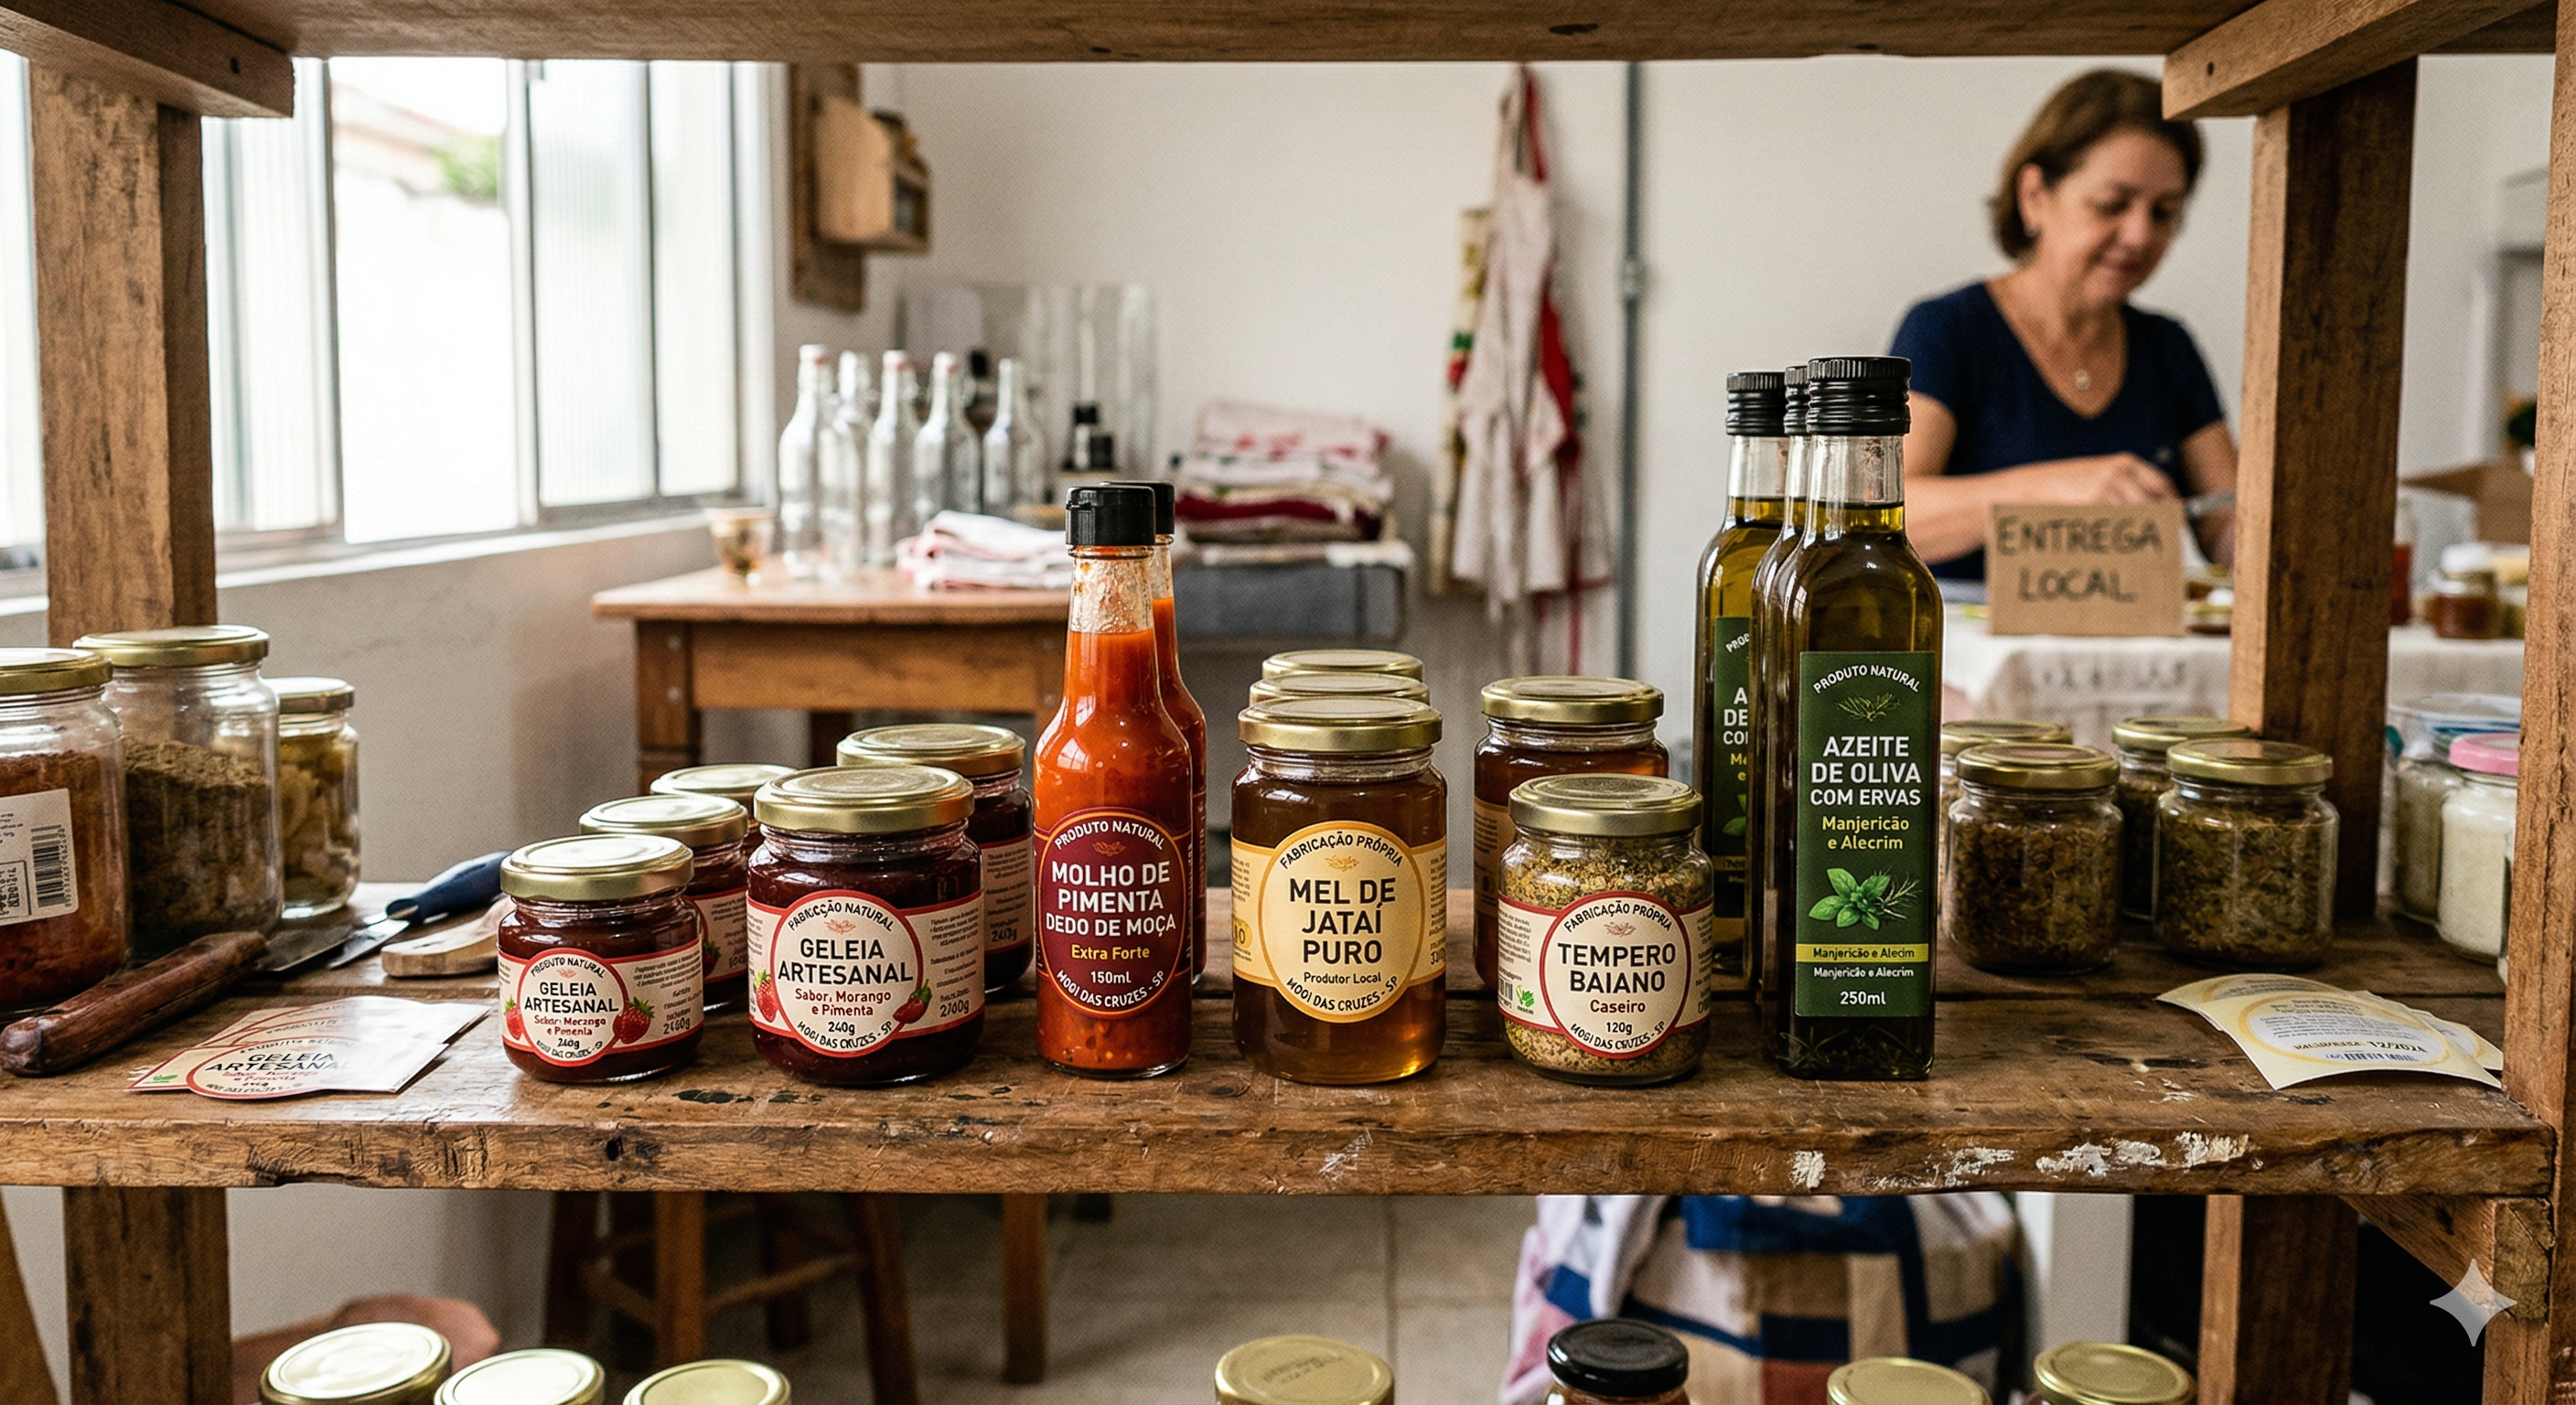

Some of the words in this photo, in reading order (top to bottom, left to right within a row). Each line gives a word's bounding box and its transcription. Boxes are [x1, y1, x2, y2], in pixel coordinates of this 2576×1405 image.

[1996, 514, 2164, 556] ENTREGA
[2018, 566, 2139, 604] LOCAL
[1812, 664, 1868, 694] PRODUTO
[1870, 664, 1922, 693] NATURAL
[1723, 708, 1748, 726] DE
[1822, 735, 1910, 757] AZEITE
[1810, 762, 1844, 784] DE
[1850, 761, 1923, 785] OLIVA
[1809, 788, 1854, 807] COM
[1859, 788, 1922, 807] ERVAS
[1054, 820, 1109, 851] PRODUTO
[1112, 820, 1165, 851] NATURAL
[1821, 815, 1910, 834] Manjericão
[1280, 831, 1354, 870] FABRICAÇÃO
[1356, 833, 1403, 868] PRÓPRIA
[1827, 837, 1838, 851] e
[1841, 834, 1904, 851] Alecrim
[1051, 860, 1135, 887] MOLHO
[1142, 860, 1171, 885] DE
[1057, 888, 1165, 914] PIMENTA
[1289, 878, 1351, 905] MEL
[1359, 877, 1396, 905] DE
[844, 902, 895, 932] NATURAL
[1046, 912, 1089, 936] DEDO
[1094, 919, 1121, 937] DE
[1126, 913, 1176, 938] MOÇA
[1302, 901, 1384, 935] JATAÍ
[1563, 900, 1630, 933] FABRICAÇÃO
[1632, 904, 1673, 932] PRÓPRIA
[800, 938, 886, 960] GELEIA
[1071, 944, 1109, 960] Extra
[1112, 945, 1150, 960] Forte
[1303, 938, 1383, 965] PURO
[1557, 942, 1677, 968] TEMPERO
[1872, 949, 1878, 958] e
[567, 958, 606, 979] NATURAL
[778, 960, 914, 985] ARTESANAL
[1090, 971, 1132, 984] 150ml
[1304, 971, 1350, 984] Produtor
[1353, 971, 1381, 984] Local
[539, 981, 597, 997] GELEIA
[1079, 989, 1102, 1006] DAS
[1104, 986, 1148, 1008] CRUZES
[1152, 970, 1164, 987] SP
[1313, 994, 1336, 1011] DAS
[1385, 975, 1398, 992] SP
[1570, 970, 1666, 994] BAIANO
[524, 996, 619, 1014] ARTESANAL
[835, 991, 892, 1004] Morango
[1590, 999, 1647, 1014] Caseiro
[1840, 991, 1887, 1005] 250ml
[811, 1005, 820, 1015] e
[821, 1003, 874, 1016] Pimenta
[828, 1021, 855, 1036] 240g
[1606, 1022, 1633, 1035] 120g
[819, 1035, 838, 1049] DAS
[1594, 1036, 1613, 1049] DAS
